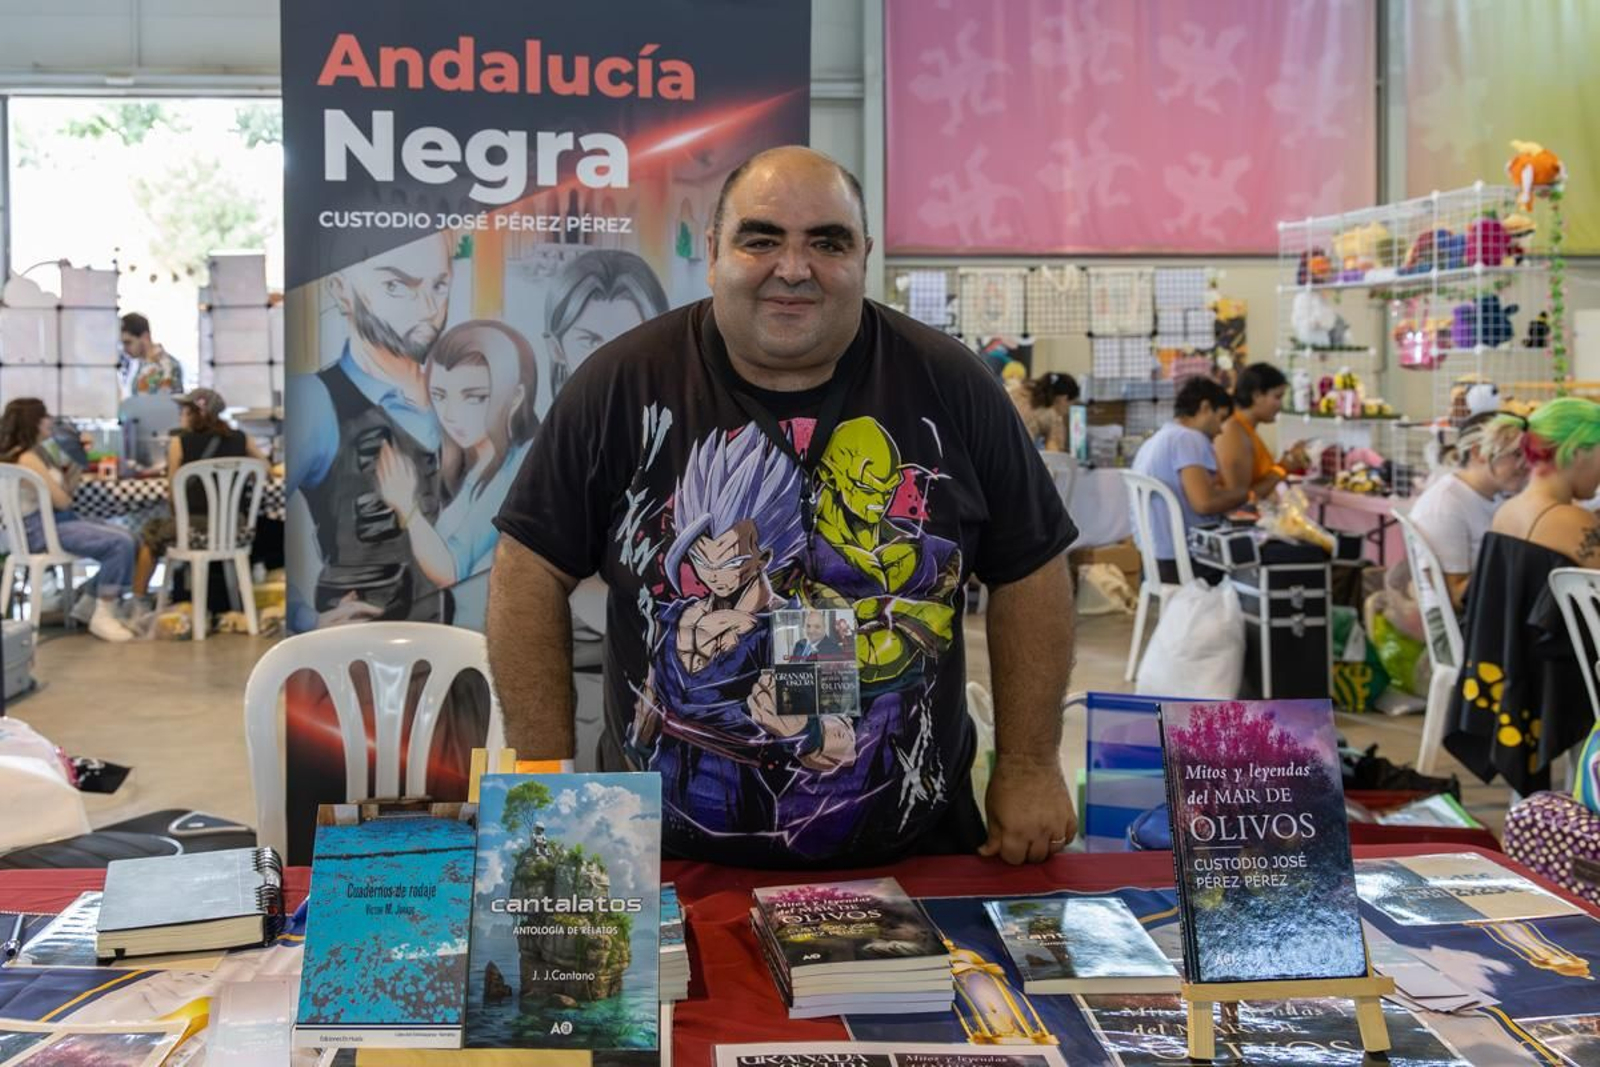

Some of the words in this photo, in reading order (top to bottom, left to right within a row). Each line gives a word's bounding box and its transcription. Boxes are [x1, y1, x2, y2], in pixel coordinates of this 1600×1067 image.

[317, 33, 697, 101] Andalucía
[324, 108, 630, 204] Negra
[318, 211, 431, 229] CUSTODIO
[435, 210, 488, 231] JOSÉ
[494, 211, 561, 232] PÉREZ
[566, 213, 633, 234] PÉREZ
[775, 672, 814, 681] GRANADA
[1185, 764, 1227, 780] Mitos
[1234, 768, 1243, 783] y
[1249, 763, 1311, 783] leyendas
[1187, 789, 1209, 805] del
[1214, 788, 1259, 804] MAR
[1266, 787, 1292, 803] DE
[1190, 812, 1317, 842] OLIVOS
[1194, 856, 1269, 872] CUSTODIO
[1273, 851, 1308, 869] JOSÉ
[1196, 873, 1240, 889] PÉREZ
[1244, 871, 1289, 888] PÉREZ
[347, 883, 393, 899] Cuadernos
[408, 882, 437, 901] rodaje
[491, 893, 643, 913] cantalatos
[775, 901, 806, 909] Mitos
[782, 909, 882, 924] OLIVOS
[512, 924, 565, 935] ANTOLOGÍA
[567, 926, 578, 935] DE
[580, 926, 618, 935] RELATOS
[532, 969, 541, 981] J.
[1132, 1023, 1166, 1036] del
